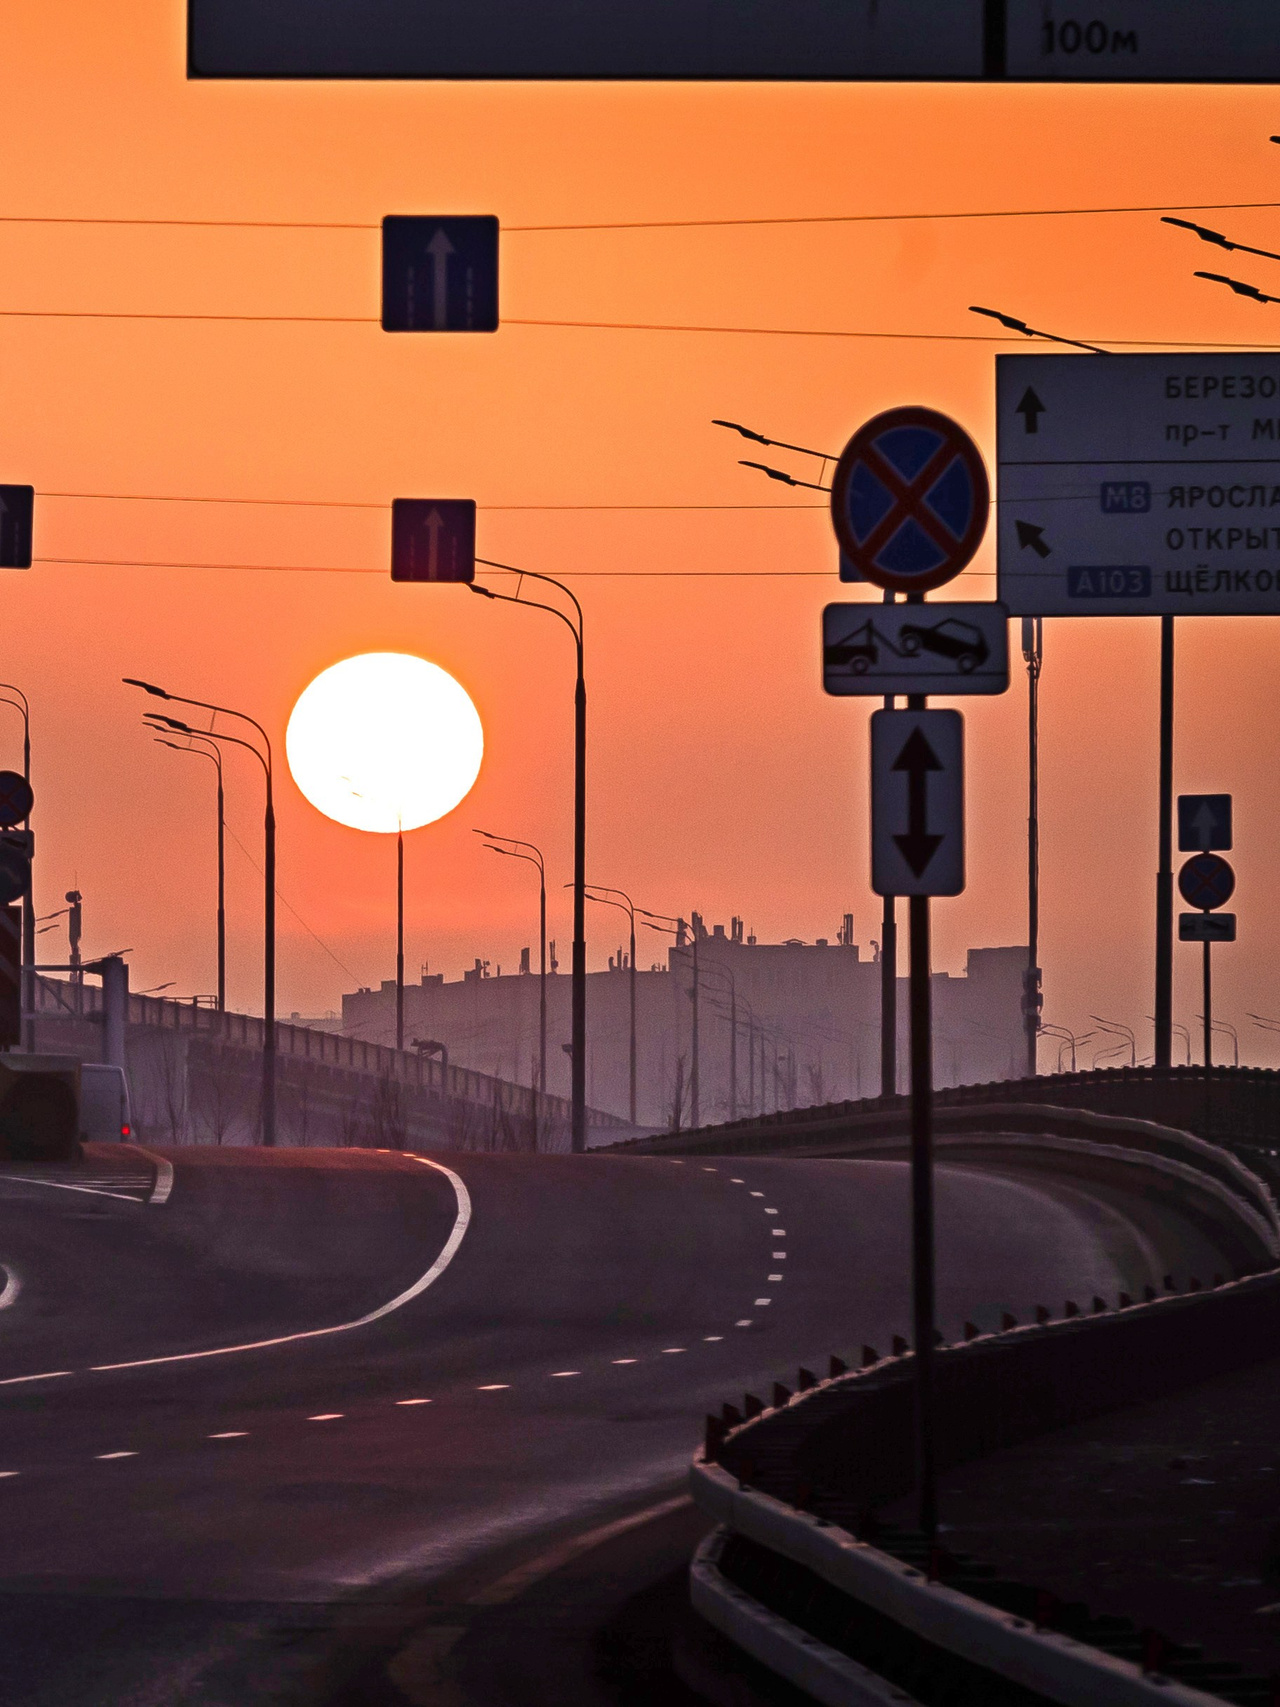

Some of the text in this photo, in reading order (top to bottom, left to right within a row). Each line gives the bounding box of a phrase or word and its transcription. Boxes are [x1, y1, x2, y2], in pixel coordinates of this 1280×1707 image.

[1043, 19, 1137, 53] 100м
[1165, 418, 1280, 446] пр-т М
[1104, 486, 1148, 509] М8
[1076, 565, 1280, 595] А103 ЩЁЛКО
